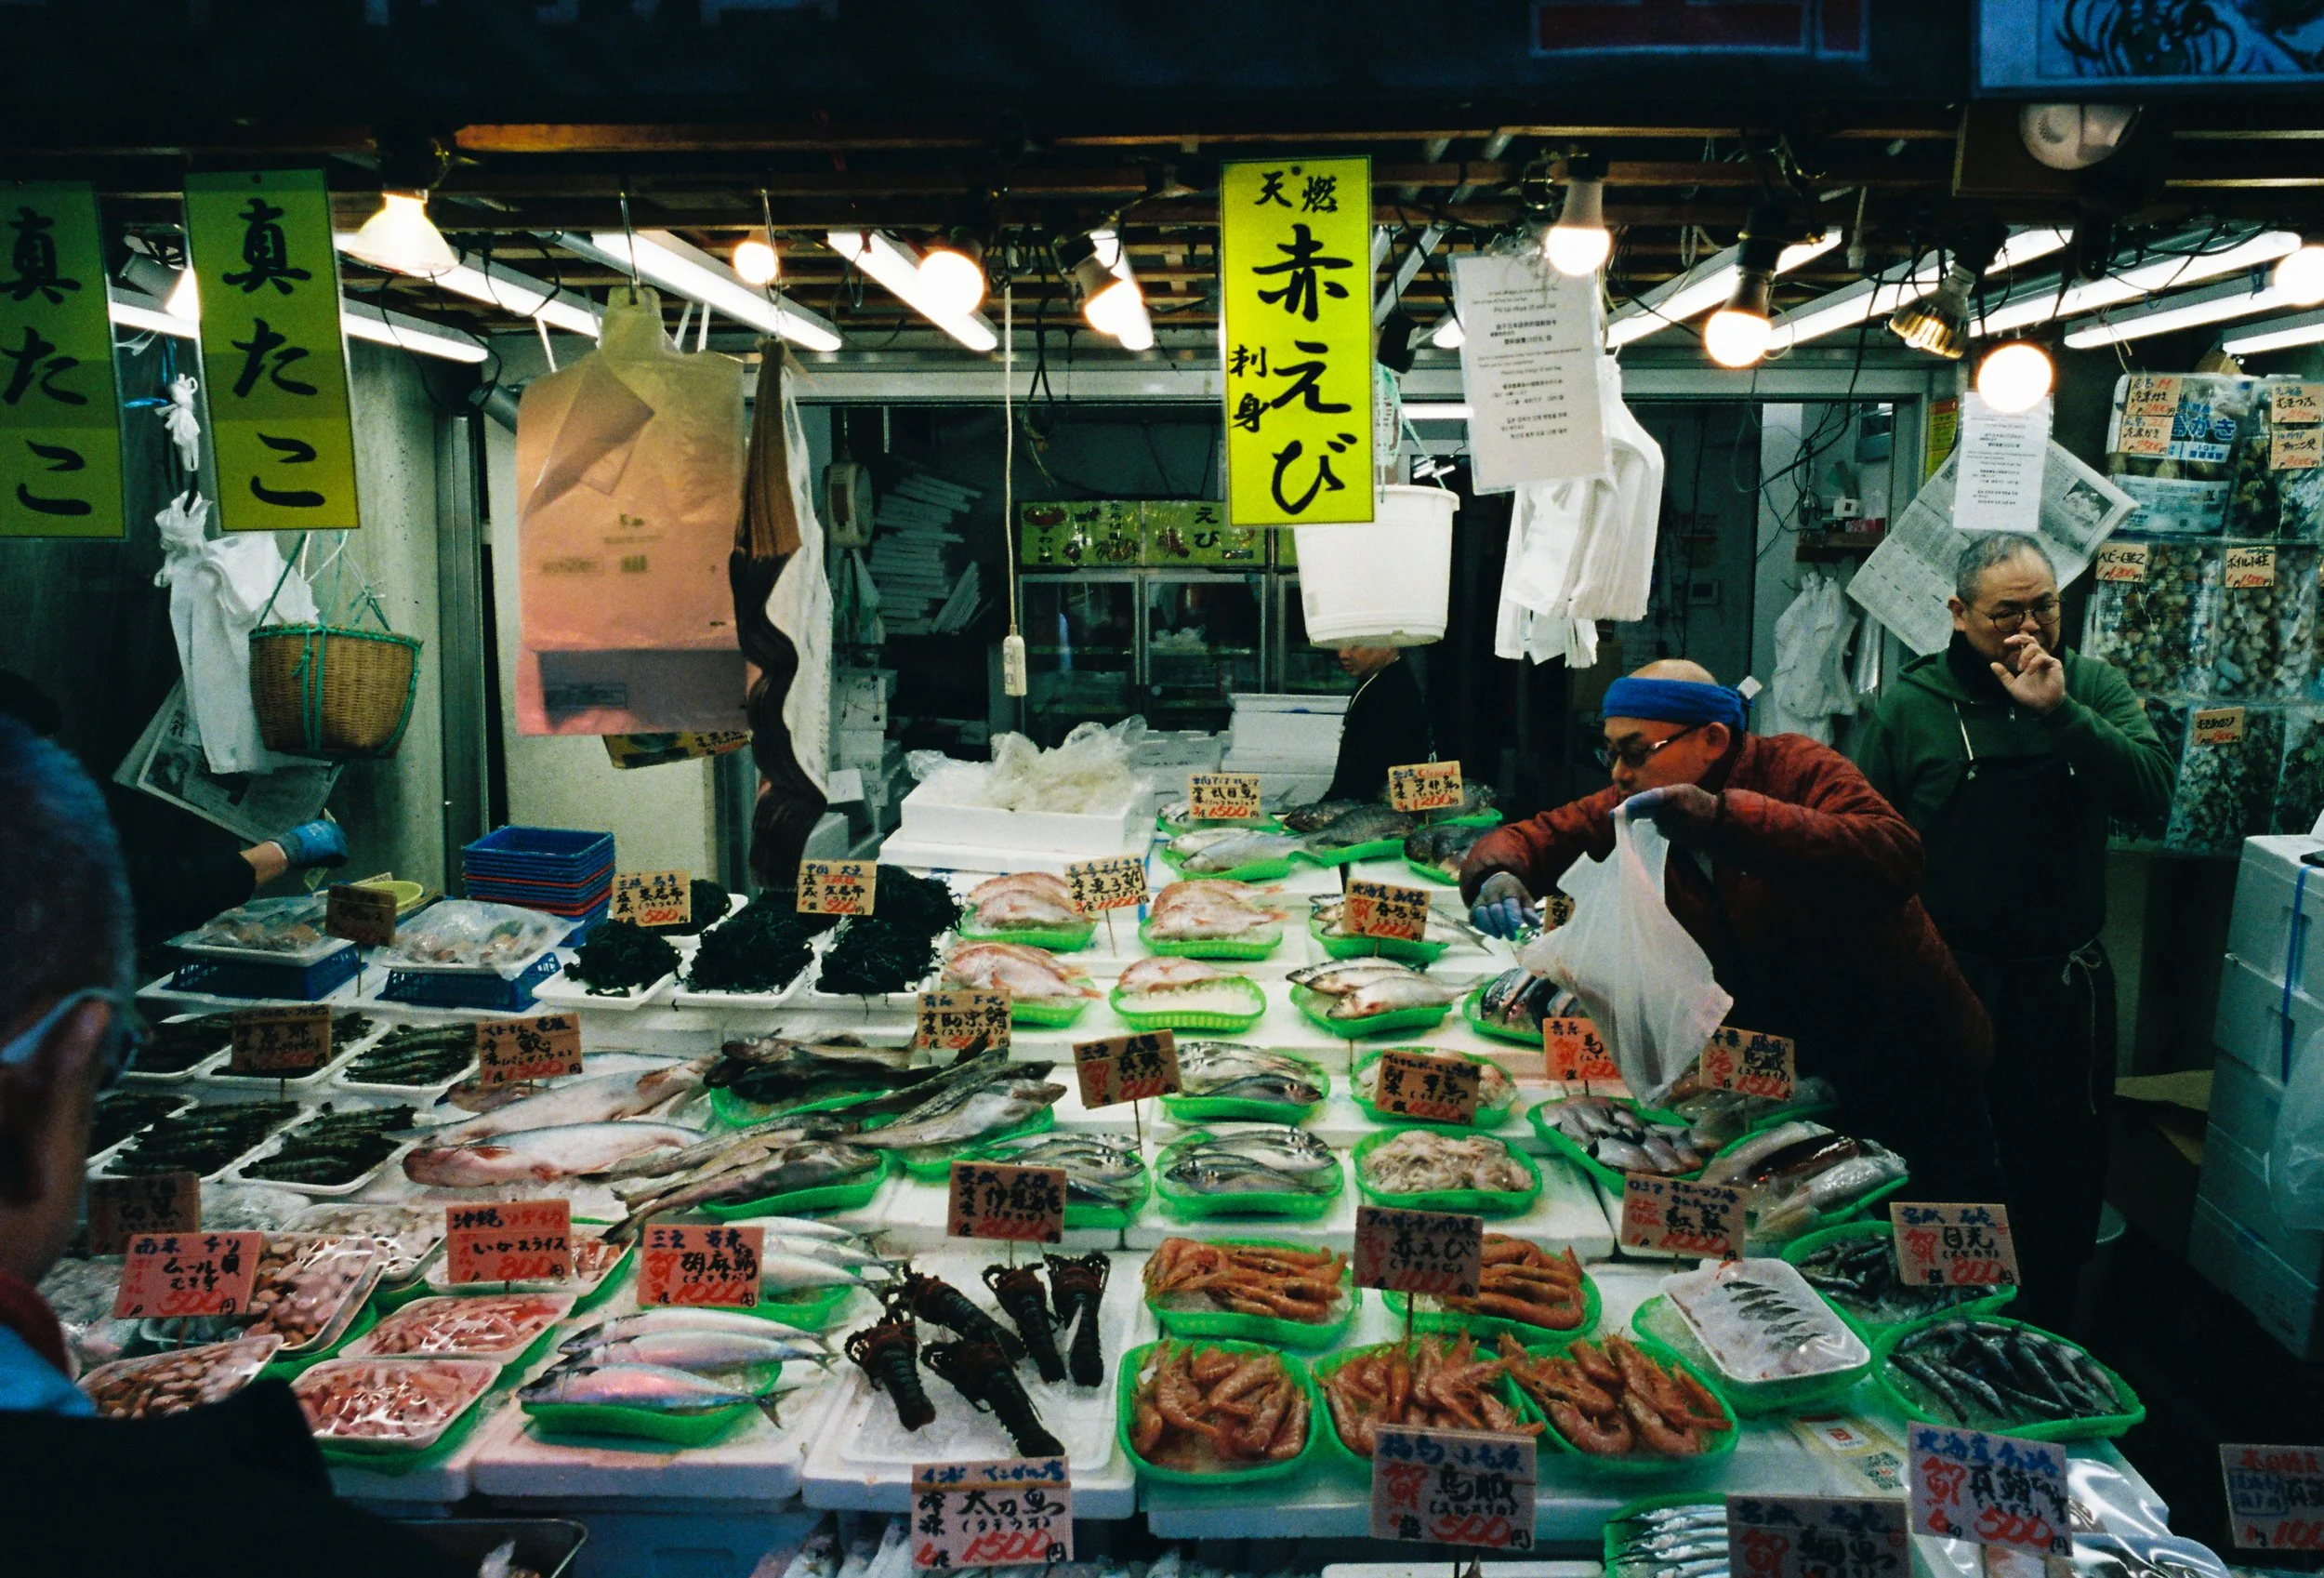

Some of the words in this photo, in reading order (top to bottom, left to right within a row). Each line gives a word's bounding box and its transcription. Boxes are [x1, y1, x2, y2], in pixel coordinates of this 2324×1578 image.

[0, 206, 91, 515] 真たこ
[222, 198, 325, 507] 真たこ
[1252, 224, 1358, 515] 赤えび
[453, 1208, 504, 1229] 沖縄
[204, 1236, 242, 1253] チリ
[472, 1238, 569, 1253] いかスライス
[680, 1245, 758, 1280] 胡麻鯖
[1918, 1428, 1993, 1464] 北海道
[957, 1488, 1066, 1518] 太刀魚
